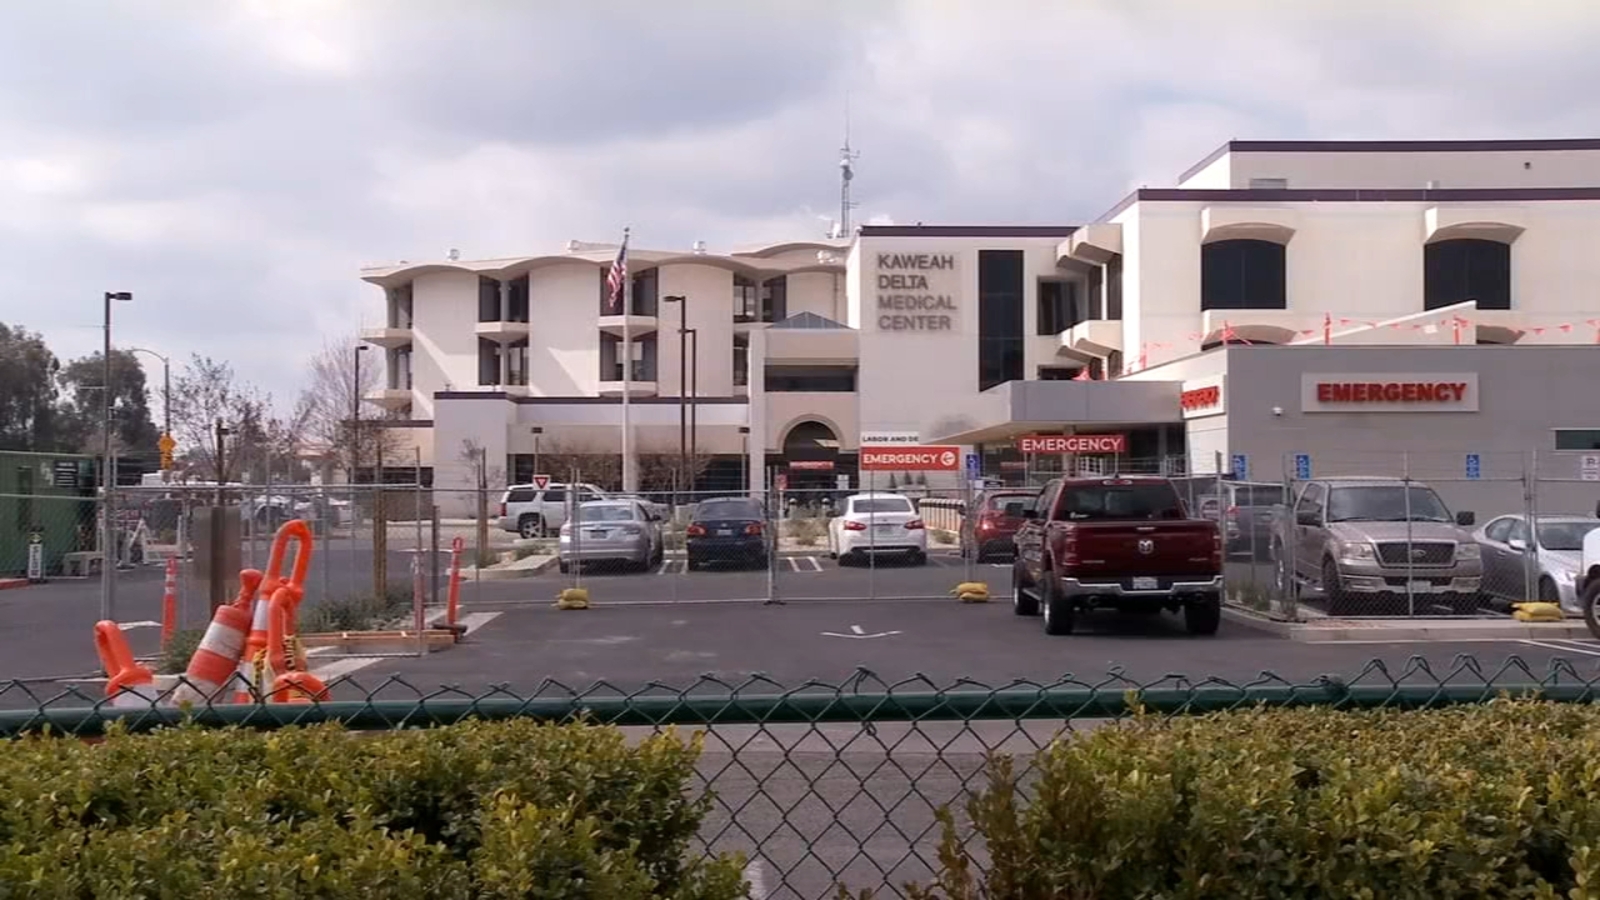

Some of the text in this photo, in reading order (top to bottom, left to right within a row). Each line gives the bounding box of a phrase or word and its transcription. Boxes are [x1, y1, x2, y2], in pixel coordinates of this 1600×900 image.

[878, 254, 954, 270] KAWEAH
[878, 274, 928, 290] DELTA
[878, 294, 957, 310] MEDICAL
[879, 314, 951, 330] CENTER
[1317, 383, 1466, 402] EMERGENCY
[862, 435, 888, 443] LABOR
[890, 435, 907, 443] AND
[1022, 438, 1121, 451] EMERGENCY
[862, 453, 938, 464] EMERGENCY
